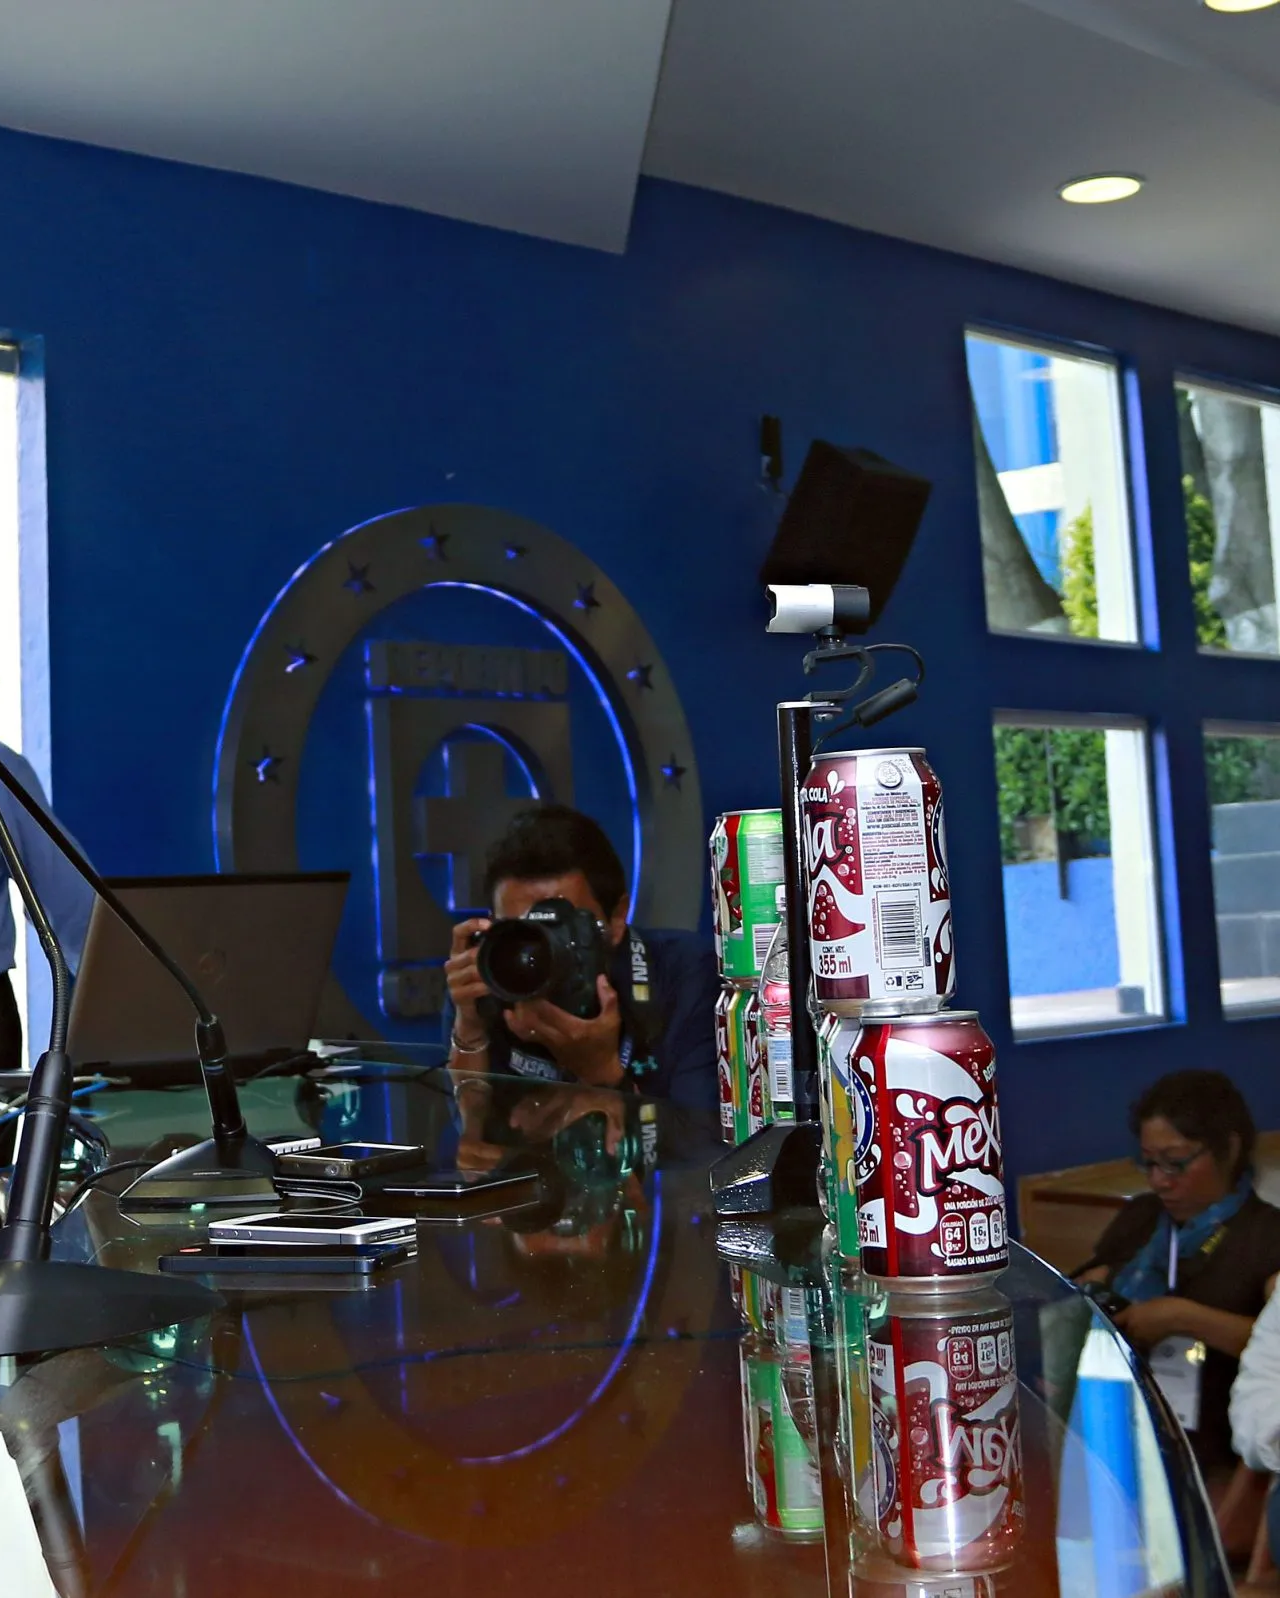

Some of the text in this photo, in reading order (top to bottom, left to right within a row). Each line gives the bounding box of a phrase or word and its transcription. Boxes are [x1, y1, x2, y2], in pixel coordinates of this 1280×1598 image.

[809, 787, 828, 804] COLA
[528, 911, 556, 921] Nikon
[630, 941, 649, 982] NPS
[839, 955, 852, 974] ml
[869, 1224, 880, 1244] ml
[945, 1227, 962, 1241] 64
